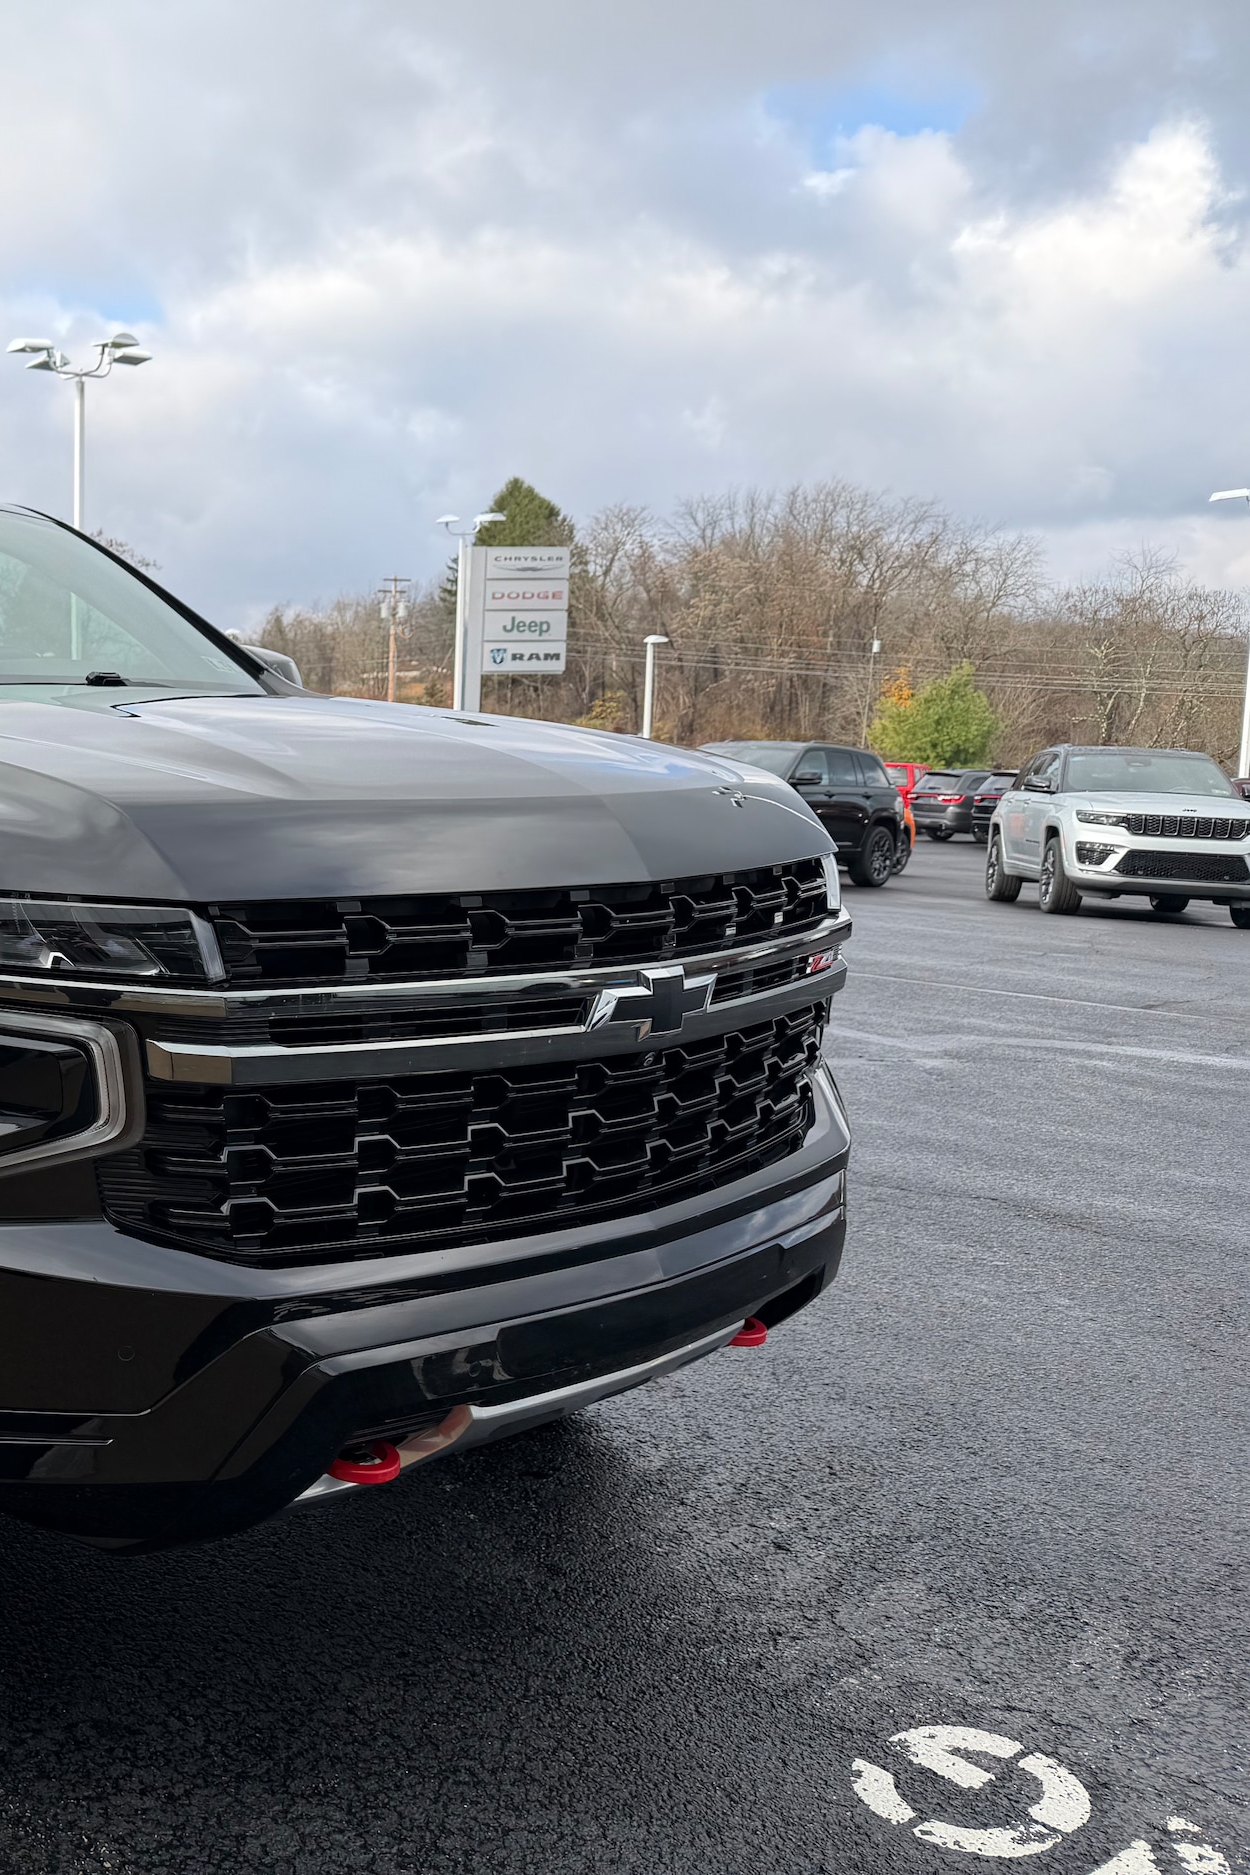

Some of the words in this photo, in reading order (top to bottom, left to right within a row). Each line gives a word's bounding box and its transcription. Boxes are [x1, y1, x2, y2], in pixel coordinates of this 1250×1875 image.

[494, 555, 563, 563] CHRYSLER
[491, 590, 563, 600] DODGE
[502, 616, 551, 637] Jeep
[511, 652, 561, 661] RAM
